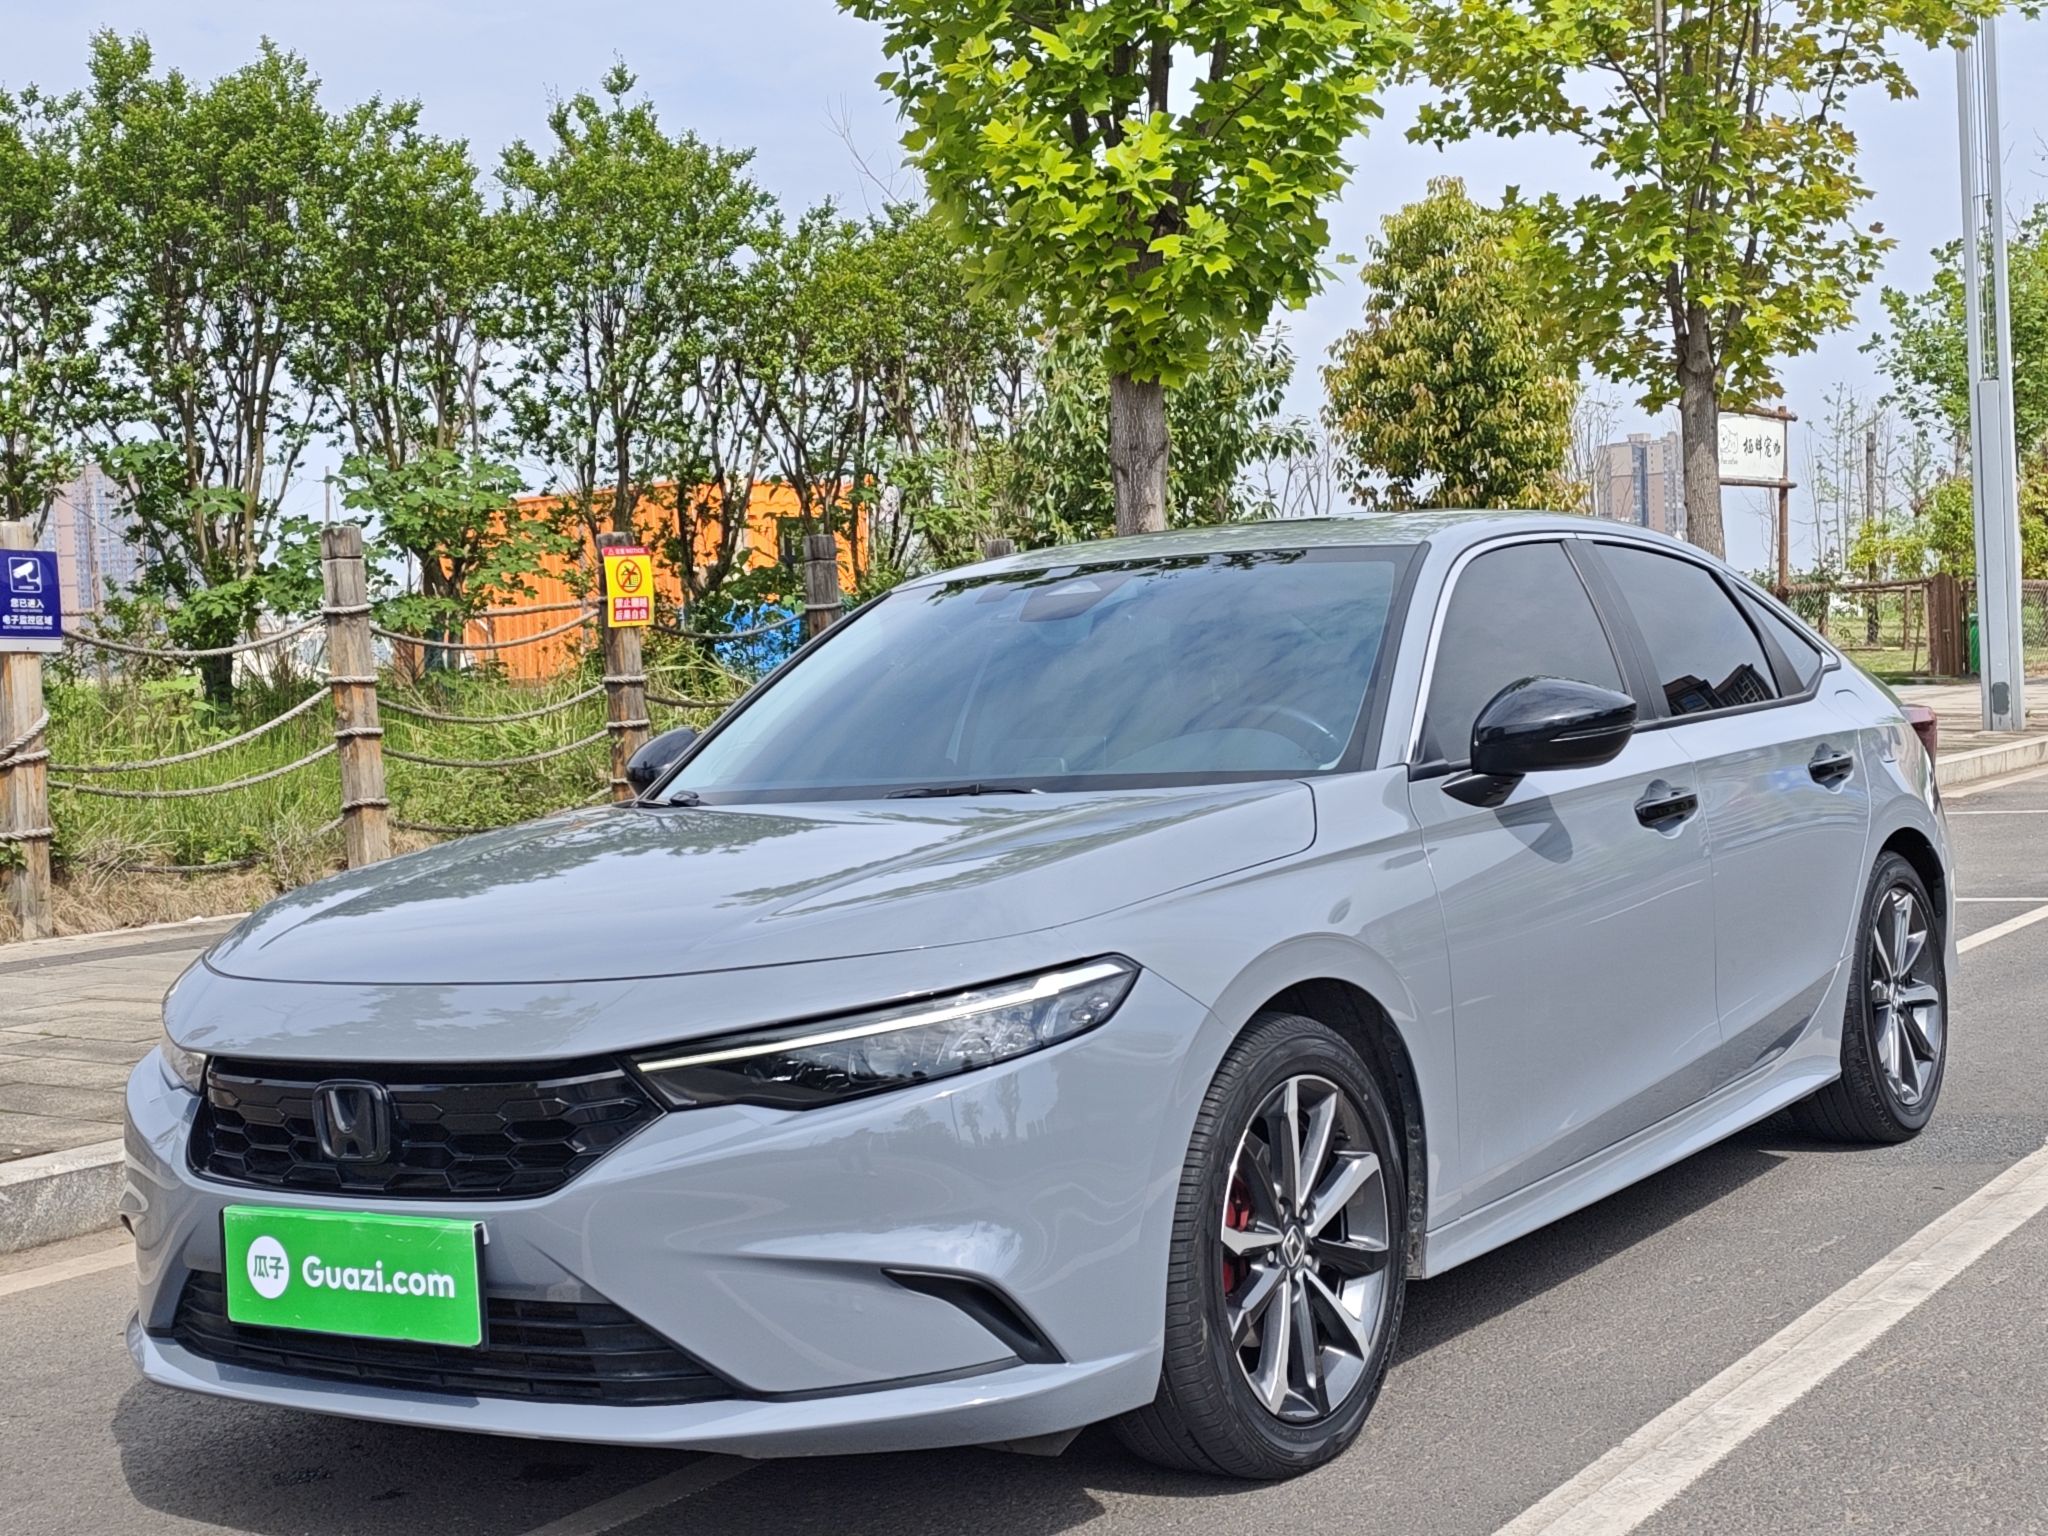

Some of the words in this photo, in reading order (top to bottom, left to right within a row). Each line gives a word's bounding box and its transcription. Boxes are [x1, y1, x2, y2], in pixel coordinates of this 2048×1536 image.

[10, 598, 44, 609] 您已进入
[2, 614, 53, 626] 电子监控区域
[252, 1254, 285, 1280] 瓜子
[301, 1254, 456, 1298] Guazi.com
